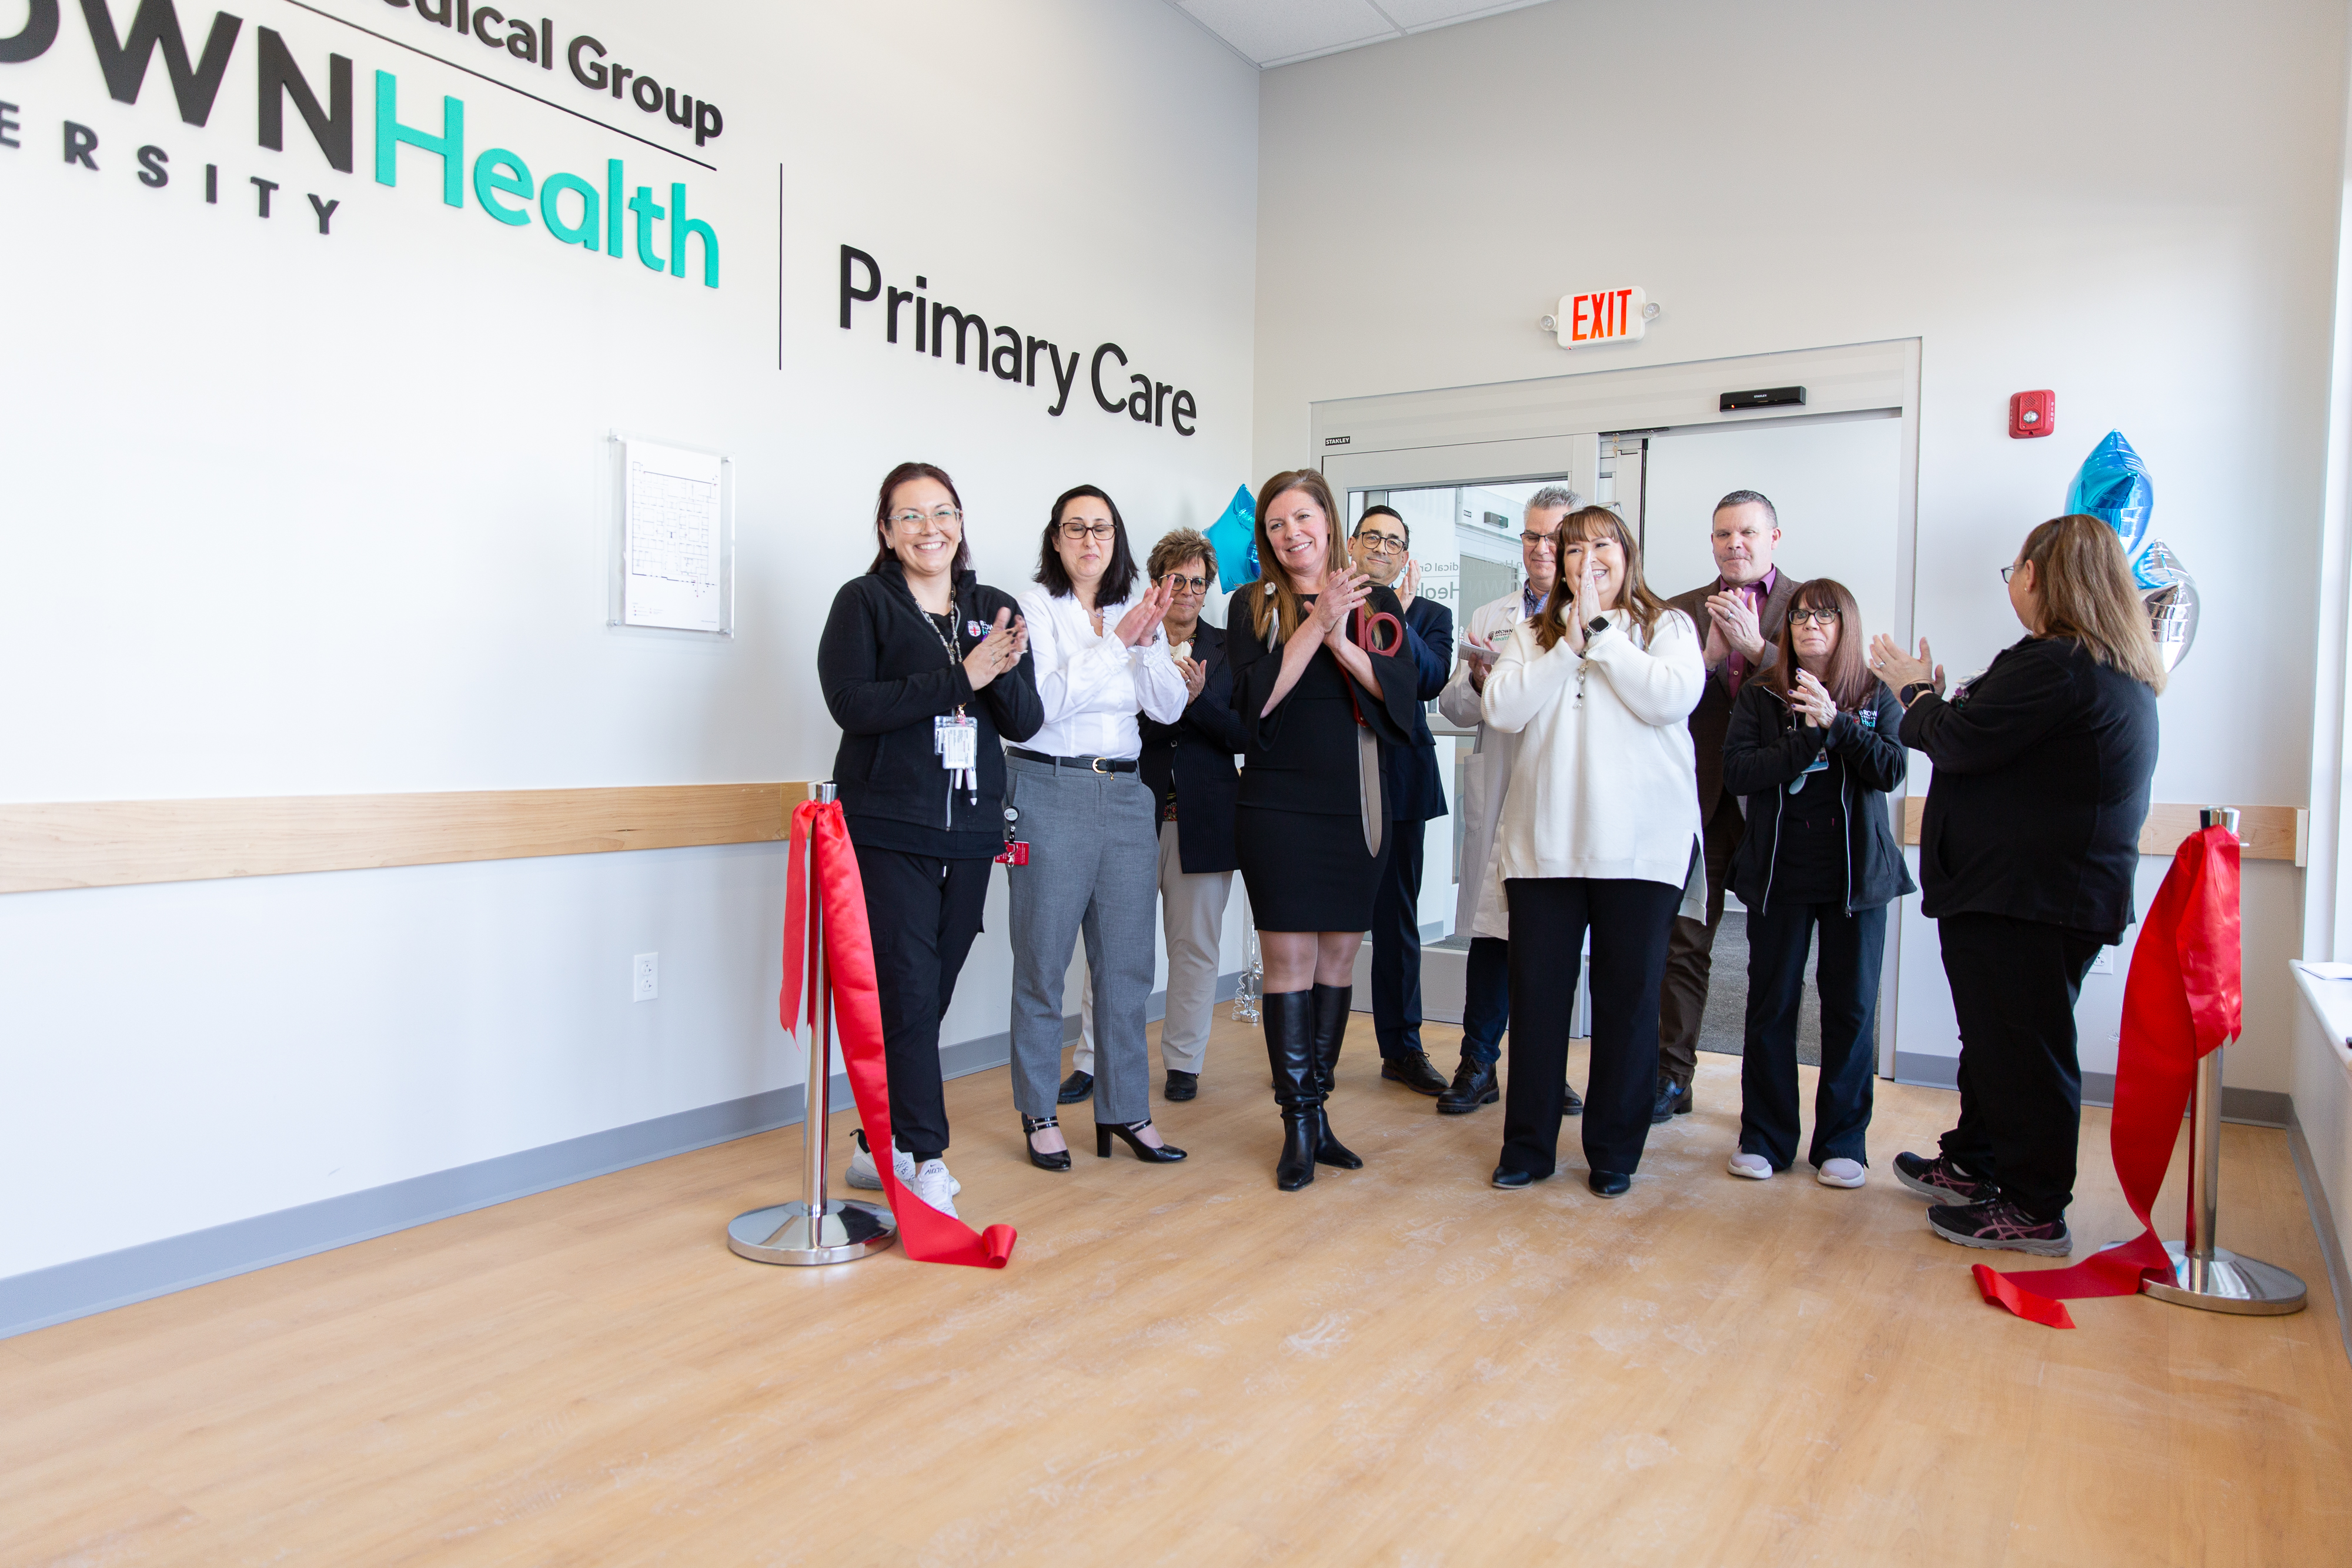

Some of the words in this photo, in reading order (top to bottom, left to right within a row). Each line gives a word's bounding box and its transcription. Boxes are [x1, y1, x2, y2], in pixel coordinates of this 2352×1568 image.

[0, 0, 354, 175] WN
[375, 69, 719, 289] Health
[567, 35, 724, 148] Group
[840, 244, 1081, 417] Primary
[1090, 342, 1197, 437] Care
[1572, 289, 1632, 342] EXIT
[1326, 437, 1349, 445] STANLEY
